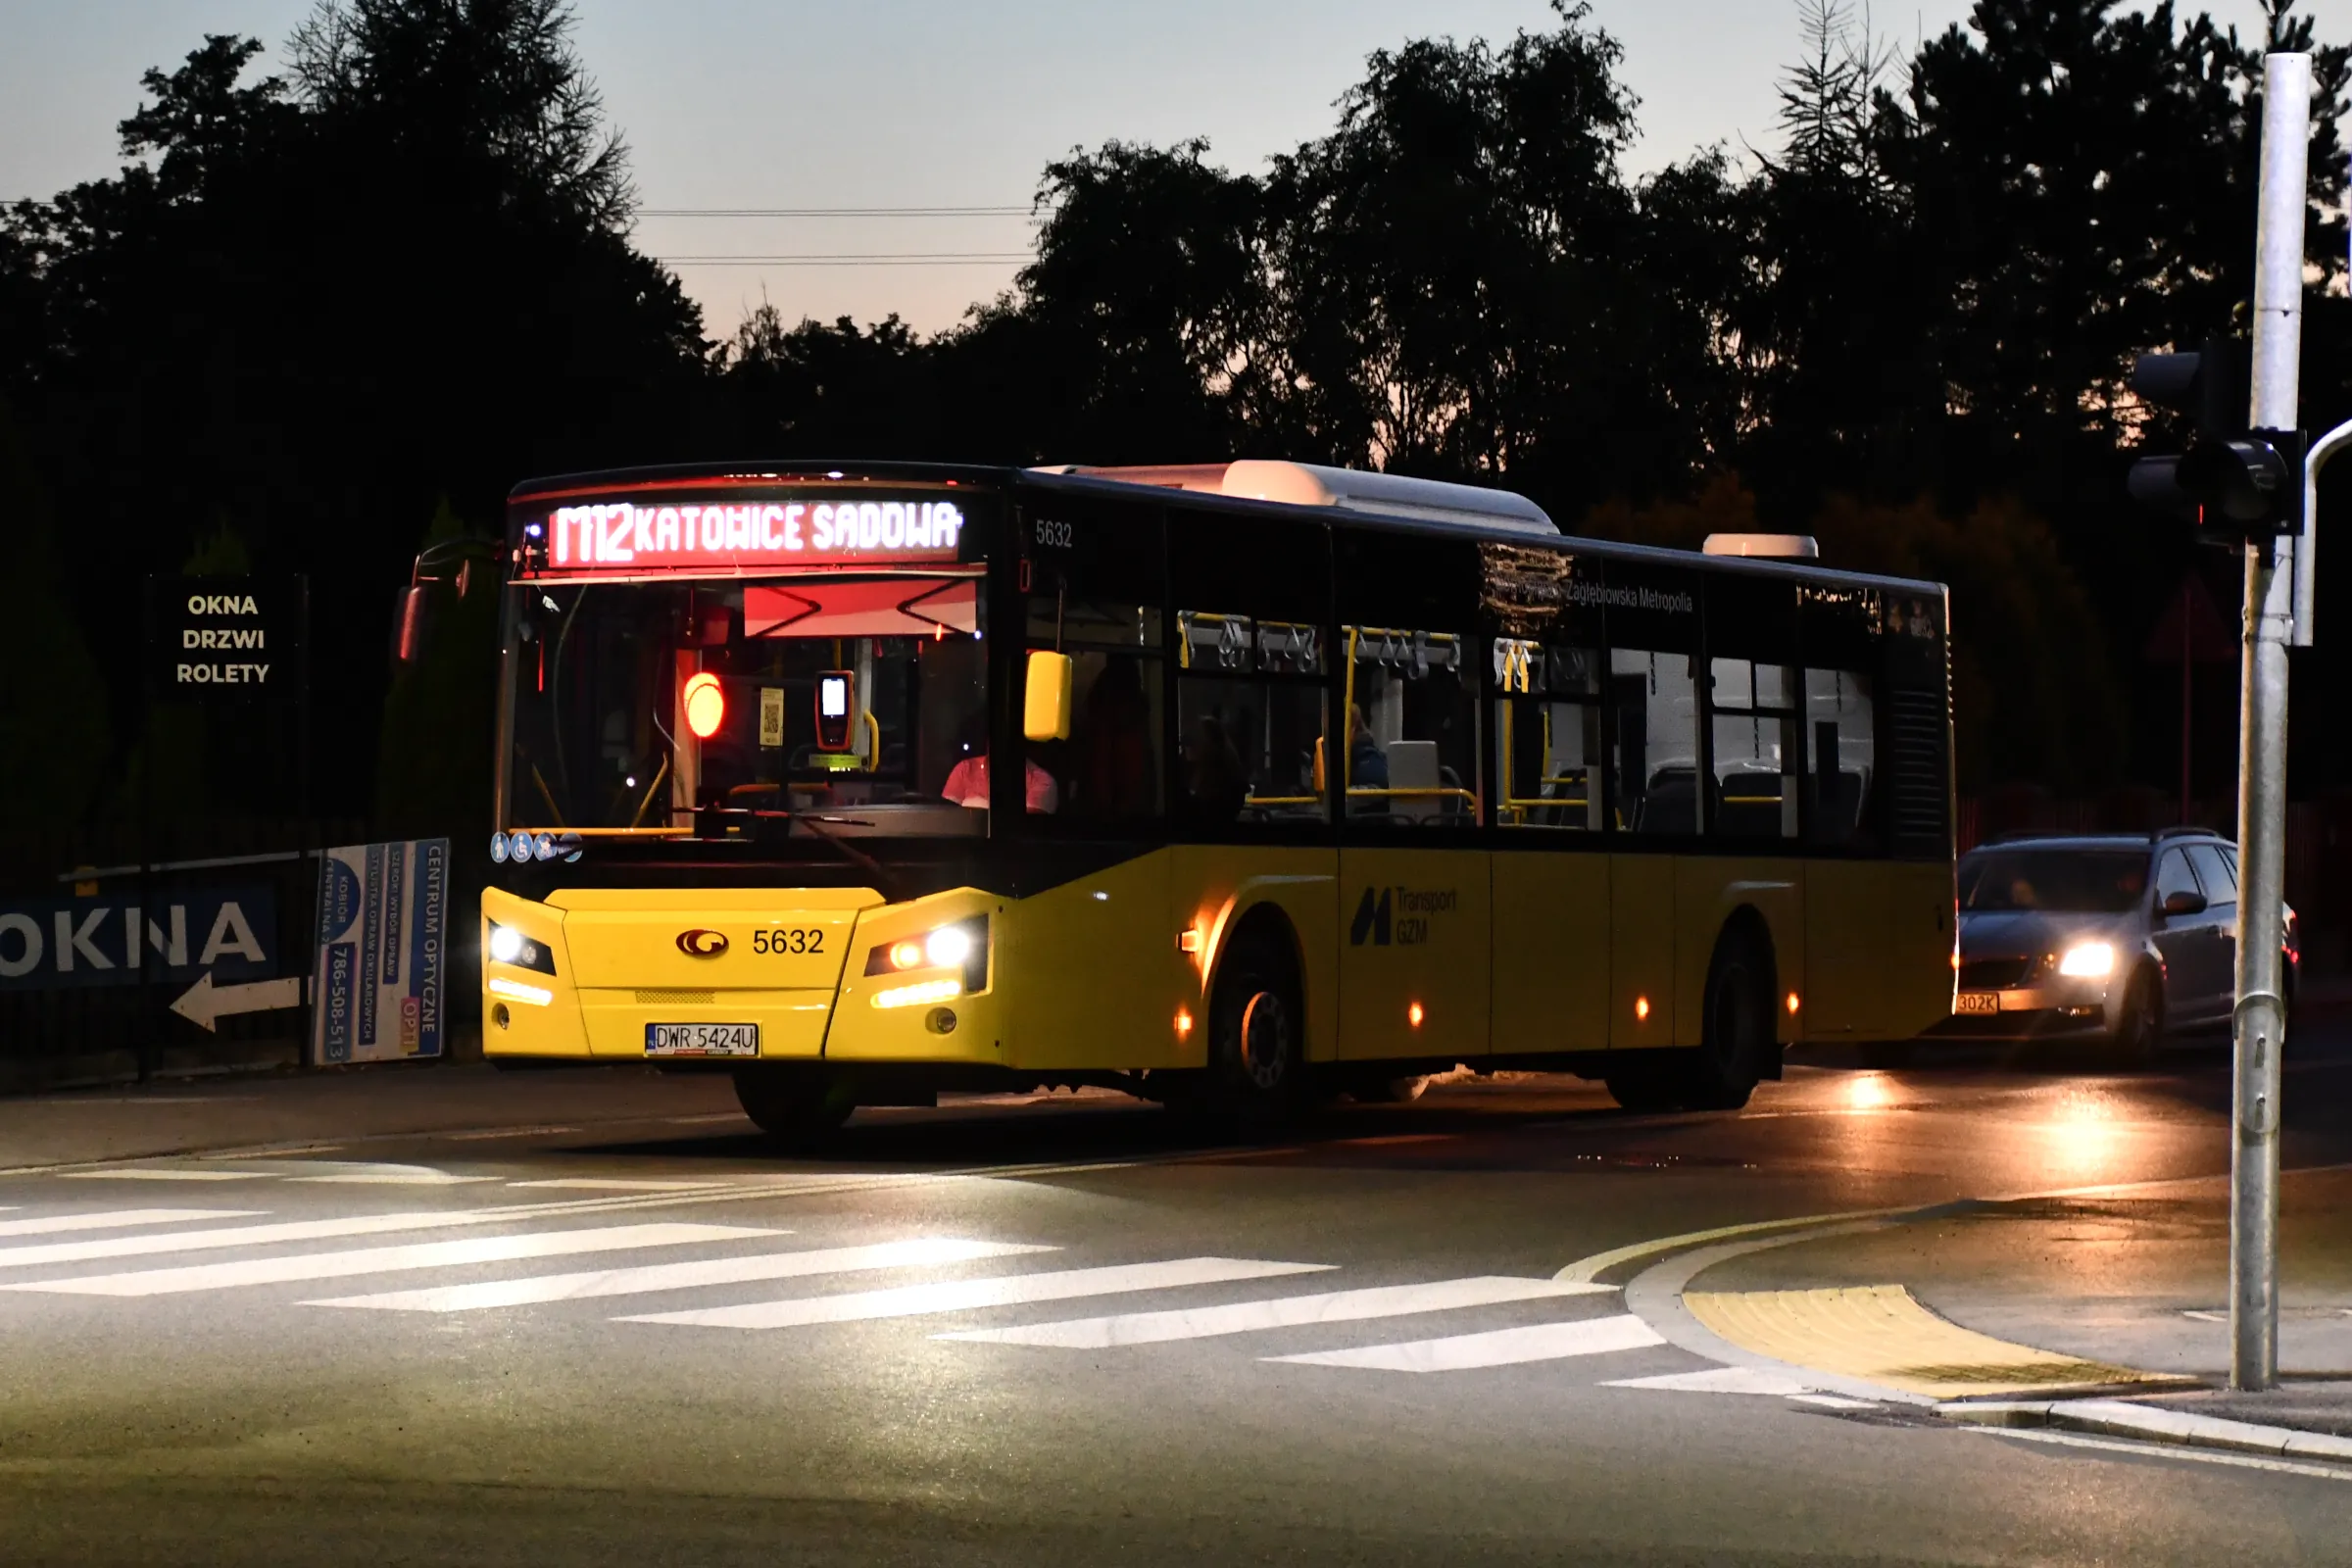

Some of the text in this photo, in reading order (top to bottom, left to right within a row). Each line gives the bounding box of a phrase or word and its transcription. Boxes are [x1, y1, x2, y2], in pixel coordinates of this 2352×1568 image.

[556, 502, 962, 563] M12 KATOWICE SADOWA
[1036, 514, 1073, 549] 5632
[187, 595, 259, 615] OKNA
[1639, 586, 1693, 614] Metropolia
[182, 629, 265, 649] DRZWI
[176, 663, 270, 684] ROLETY
[338, 875, 350, 923] KOBIÓR
[388, 896, 399, 935] WYBÓR
[1396, 886, 1457, 917] Transport
[0, 901, 268, 978] OKNA
[421, 846, 441, 1033] CENTRUM OPTYCZNE
[753, 929, 824, 955] 5632
[1396, 917, 1429, 945] GZM
[386, 937, 397, 977] OPRAW
[329, 948, 348, 1058] 786-508-513
[657, 1027, 754, 1048] DWR 5424U
